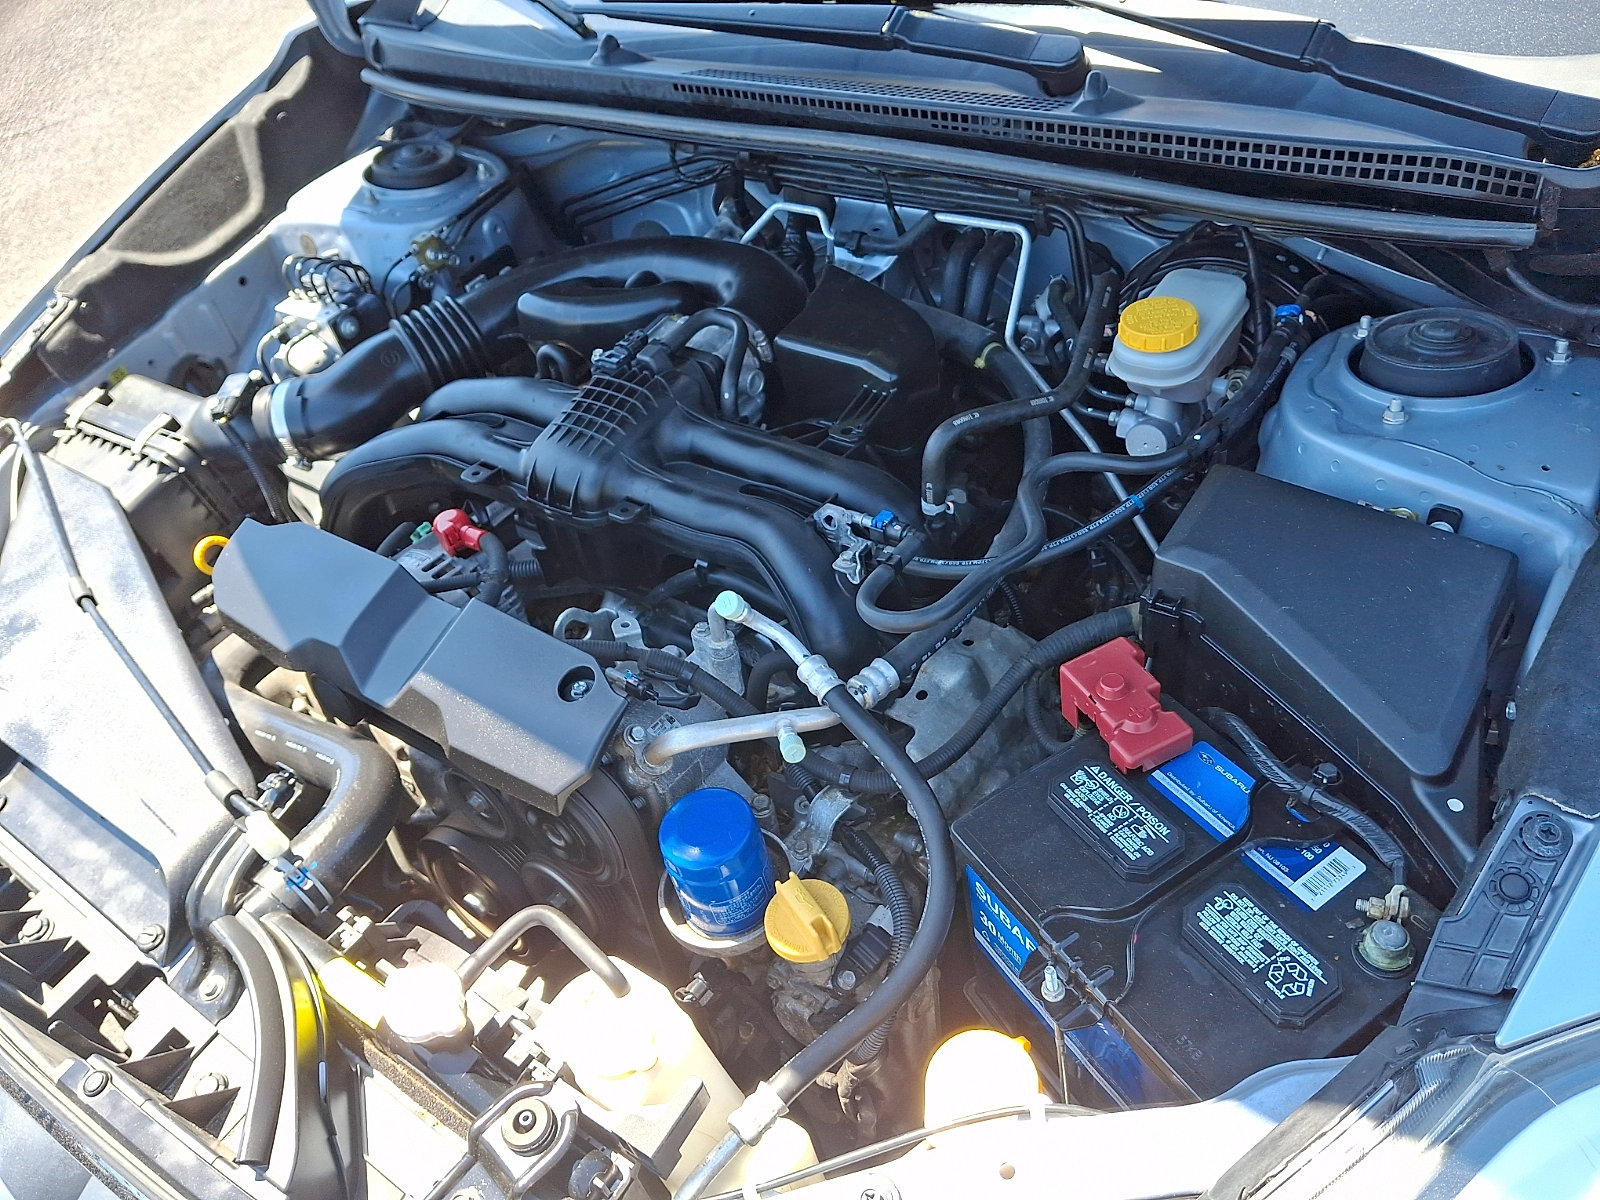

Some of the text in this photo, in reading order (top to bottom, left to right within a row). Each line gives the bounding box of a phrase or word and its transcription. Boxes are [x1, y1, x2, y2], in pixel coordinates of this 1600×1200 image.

[1214, 764, 1250, 793] SUBARU
[1073, 788, 1088, 801] GASES
[1078, 785, 1101, 806] EXPLOSIVE
[1091, 790, 1104, 801] EYES
[1096, 787, 1113, 801] SHIELD
[1166, 771, 1190, 791] Distributed
[1195, 795, 1212, 810] Subaru
[1097, 771, 1133, 802] DANGER
[1135, 805, 1170, 835] POISON
[1106, 812, 1116, 821] NO
[1121, 826, 1154, 856] SULFURIC ACID
[1264, 852, 1274, 861] NJ
[1300, 849, 1314, 860] 100
[979, 911, 997, 937] 30
[1263, 980, 1285, 1000] RECYCLE
